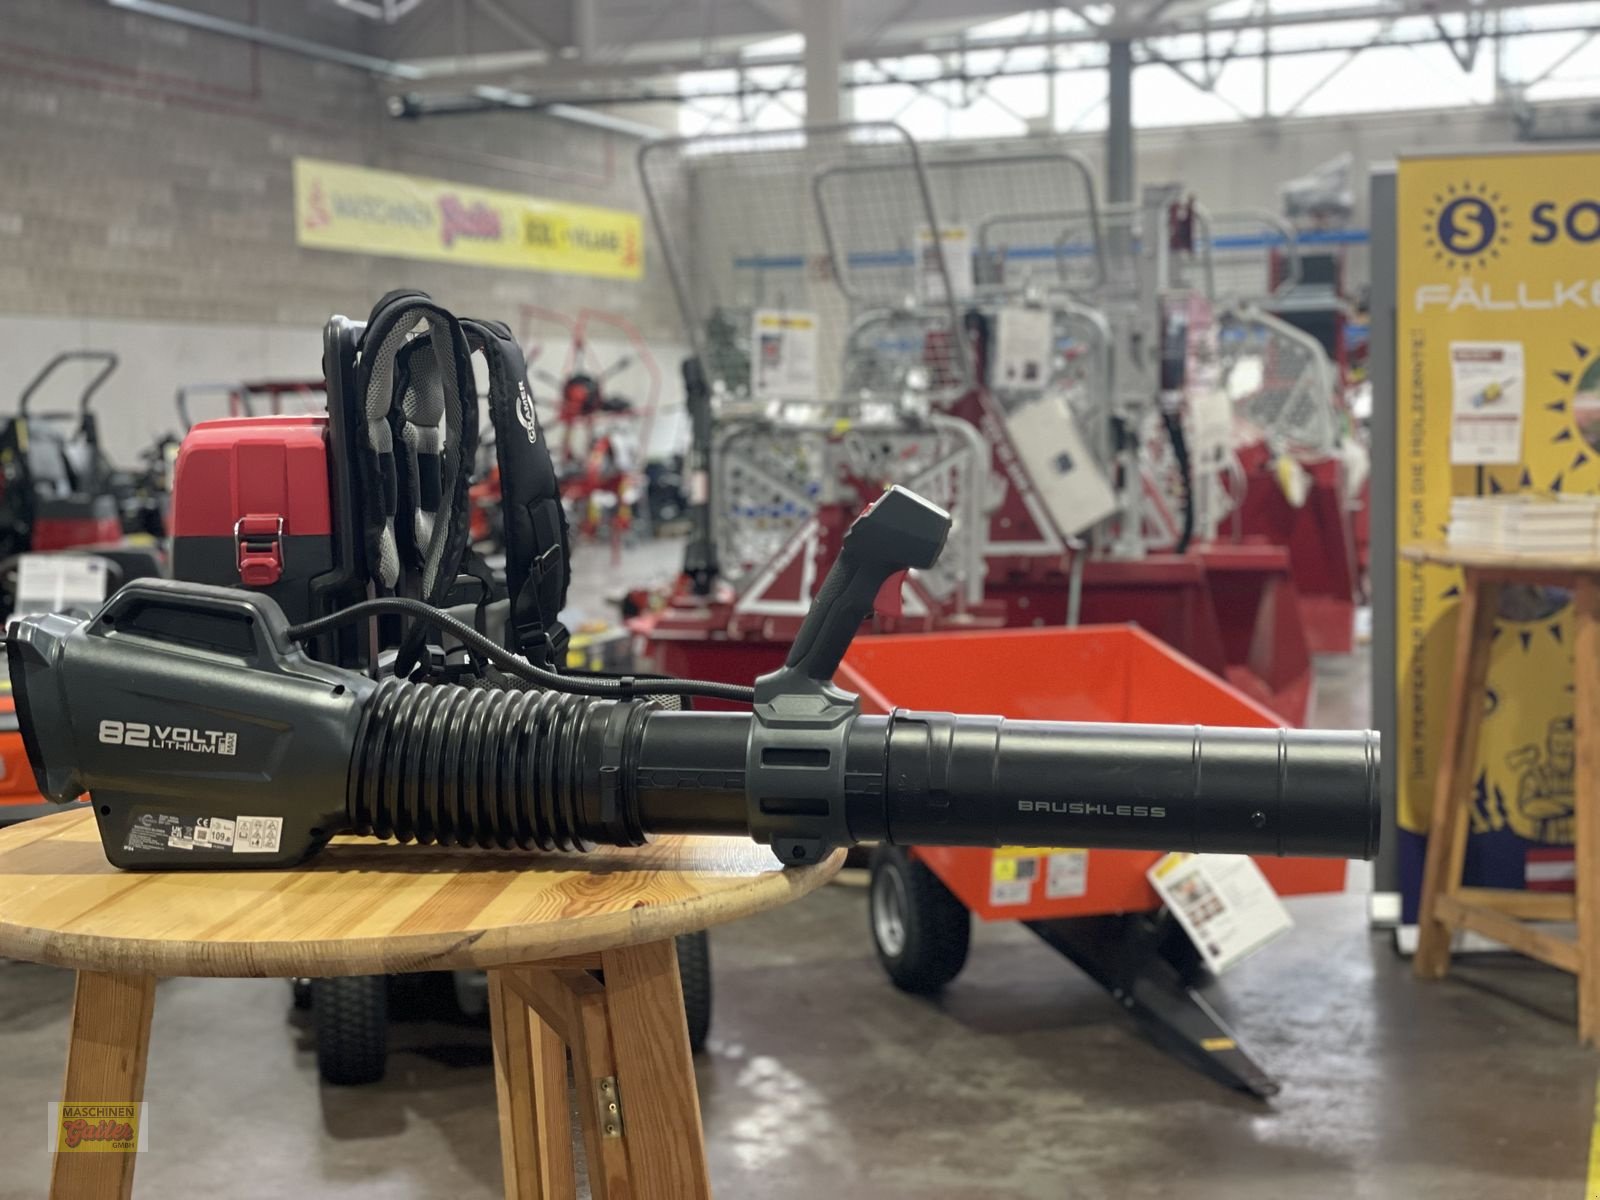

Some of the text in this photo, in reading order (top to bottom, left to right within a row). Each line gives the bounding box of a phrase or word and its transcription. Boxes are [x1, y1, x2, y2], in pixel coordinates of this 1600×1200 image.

[1415, 276, 1600, 313] FÄLLK
[99, 720, 223, 747] 82 VOLT
[152, 739, 216, 754] LITHIUM
[1018, 800, 1166, 818] BRUSHLESS
[212, 831, 225, 841] 109
